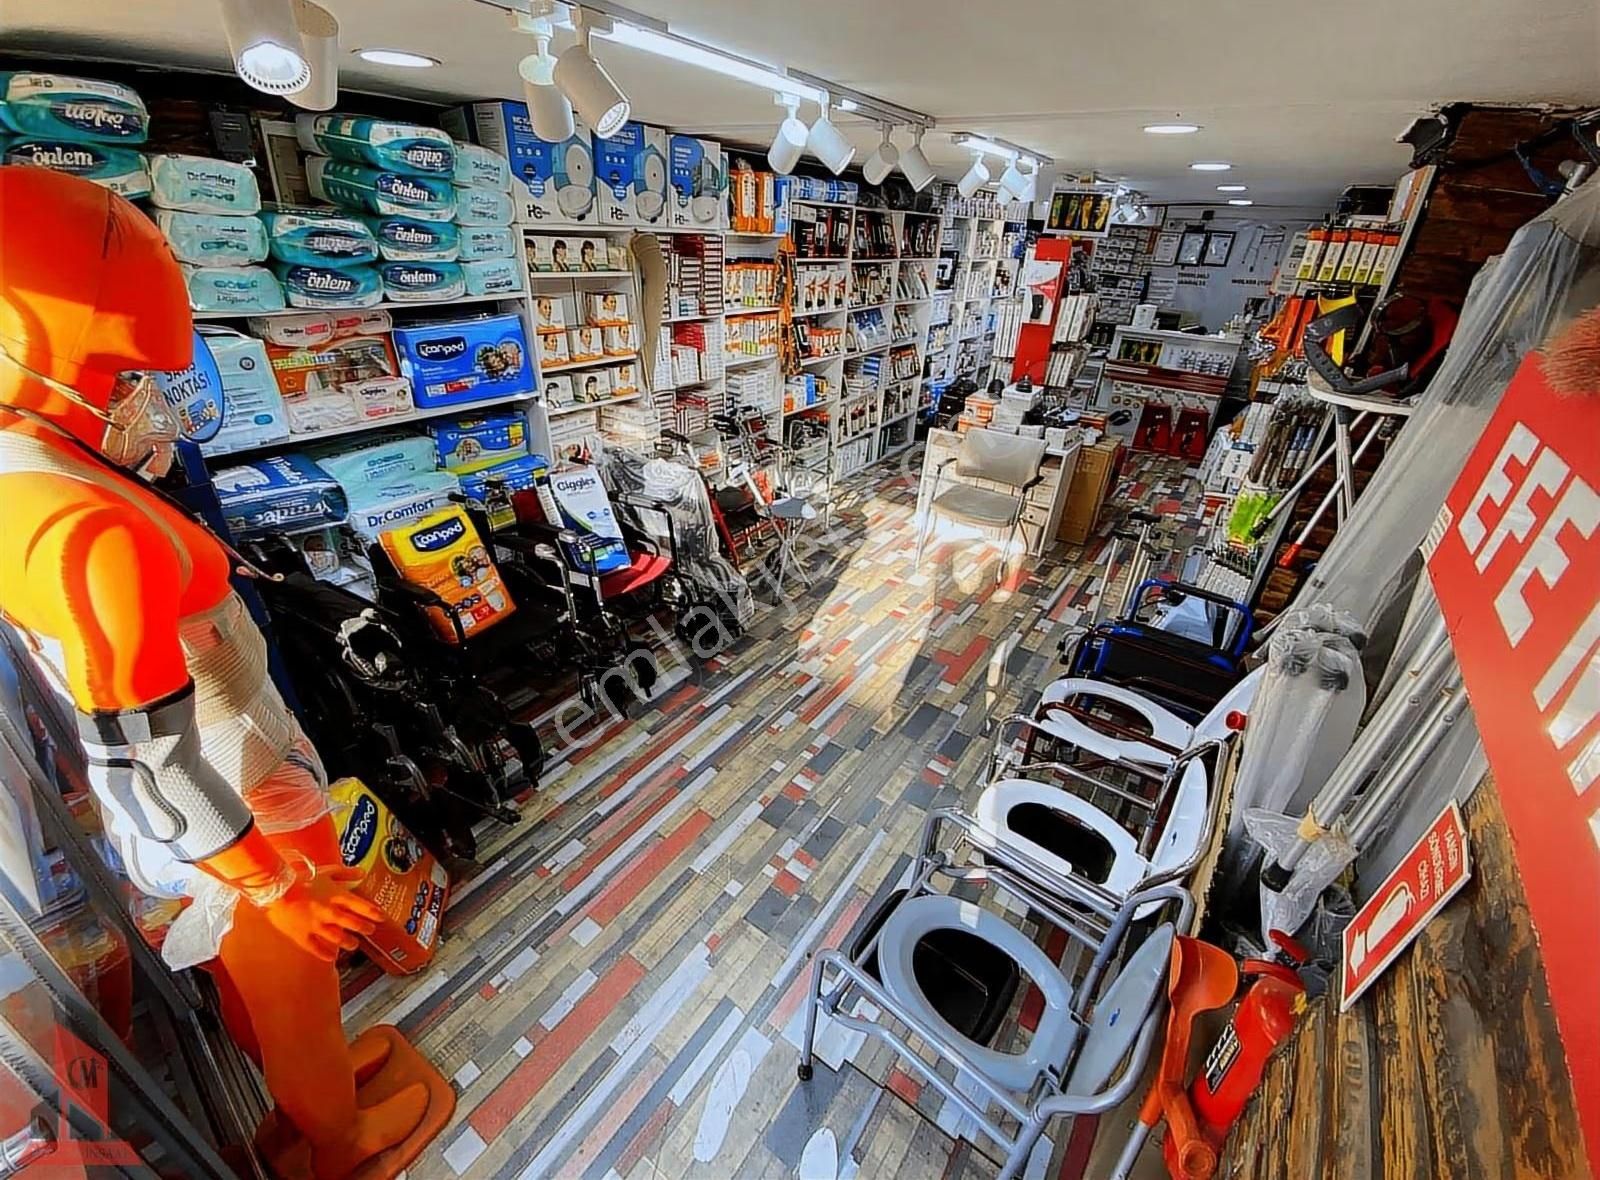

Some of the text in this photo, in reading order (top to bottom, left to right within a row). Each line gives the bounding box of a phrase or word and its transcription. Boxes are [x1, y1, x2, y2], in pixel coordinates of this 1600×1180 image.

[32, 146, 94, 166] önlem
[391, 173, 430, 201] önlem
[395, 227, 433, 245] önlem
[307, 272, 352, 292] önlem
[400, 269, 437, 284] önlem
[162, 370, 212, 408] NOKTASI
[556, 477, 597, 491] Giggles
[367, 498, 436, 529] Dr.Comfort
